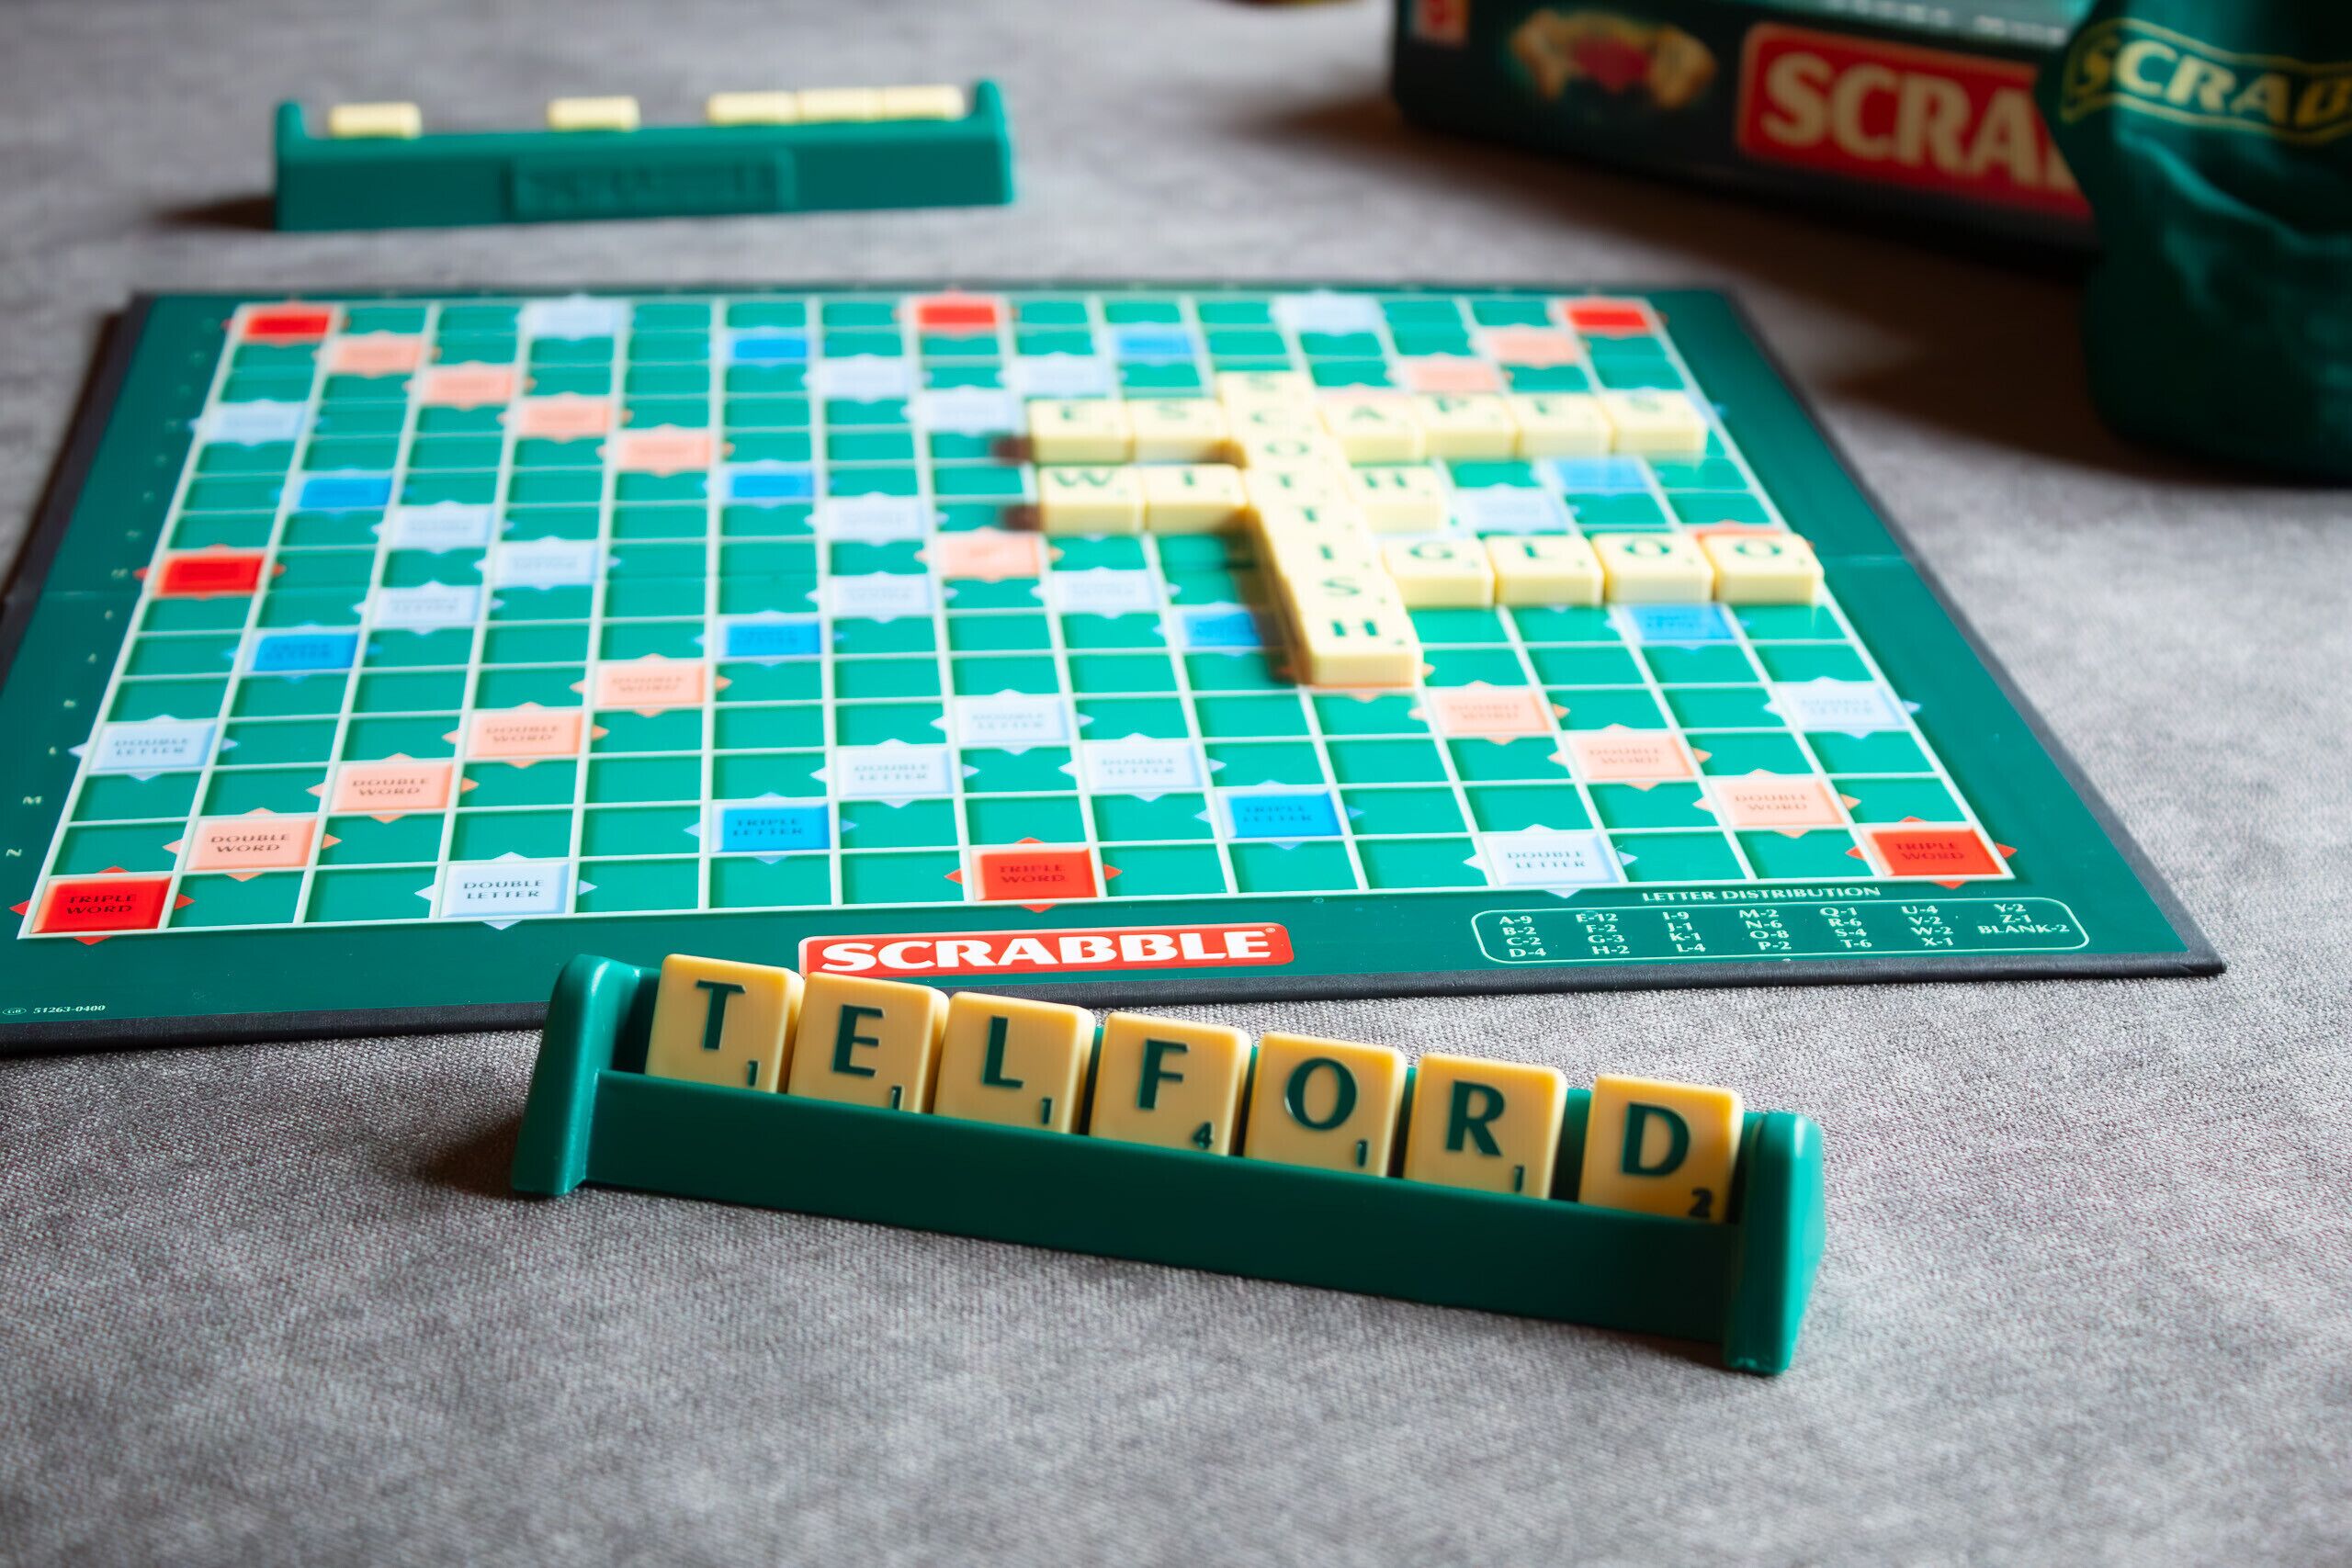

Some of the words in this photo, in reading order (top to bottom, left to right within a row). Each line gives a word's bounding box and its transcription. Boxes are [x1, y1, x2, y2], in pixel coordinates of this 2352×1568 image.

[352, 777, 430, 787] DOUBLE
[358, 786, 421, 796] WORD
[209, 833, 290, 843] DOUBLE
[215, 842, 281, 852] WORD
[1895, 842, 1960, 851] TRIPLE
[1507, 851, 1583, 860] DOUBLE
[1900, 852, 1965, 861] WORD
[999, 864, 1066, 874] TRIPLE
[1515, 861, 1587, 870] LETTER
[1000, 874, 1066, 884] WORD
[463, 879, 544, 890] DOUBLE
[68, 894, 137, 904] TRIPLE
[466, 890, 540, 900] LETTER
[1642, 889, 1717, 902] LETTER
[1722, 886, 1882, 900] DISTRIBUTION
[65, 905, 133, 915] WORD
[1818, 907, 1859, 918] Q-1
[1901, 905, 1939, 915] U-4
[1993, 904, 2028, 912] Y-2
[1576, 913, 1619, 923] E-12
[1662, 911, 1690, 920] I-9
[1738, 909, 1780, 919] M-2
[2000, 914, 2032, 924] Z-1
[1498, 915, 1532, 925] A-9
[1745, 919, 1783, 930] N-6
[1827, 918, 1862, 928] R-6
[1907, 916, 1943, 925] V-2
[1502, 926, 1537, 936] B-2
[1586, 924, 1619, 933] F-2
[1834, 928, 1867, 938] S-4
[1910, 926, 1954, 936] W-2
[1976, 923, 2070, 934] BLANK-2
[1506, 937, 1542, 946] C-2
[1588, 934, 1625, 944] G-3
[1839, 939, 1872, 949] T-6
[1920, 936, 1954, 947] X-1
[1590, 945, 1630, 955] H-2
[1675, 942, 1706, 953] L-4
[1758, 941, 1792, 951] P-2
[820, 931, 1272, 972] SCRABBLE
[1509, 947, 1547, 958] D-4
[33, 1004, 107, 1015] 51263-0400
[746, 1060, 761, 1088] 1
[889, 1085, 903, 1111] 1
[1039, 1096, 1054, 1125] 1
[1192, 1122, 1215, 1150] 4
[1353, 1139, 1369, 1168] 1
[1512, 1164, 1526, 1192] 1
[1687, 1187, 1713, 1219] 2
